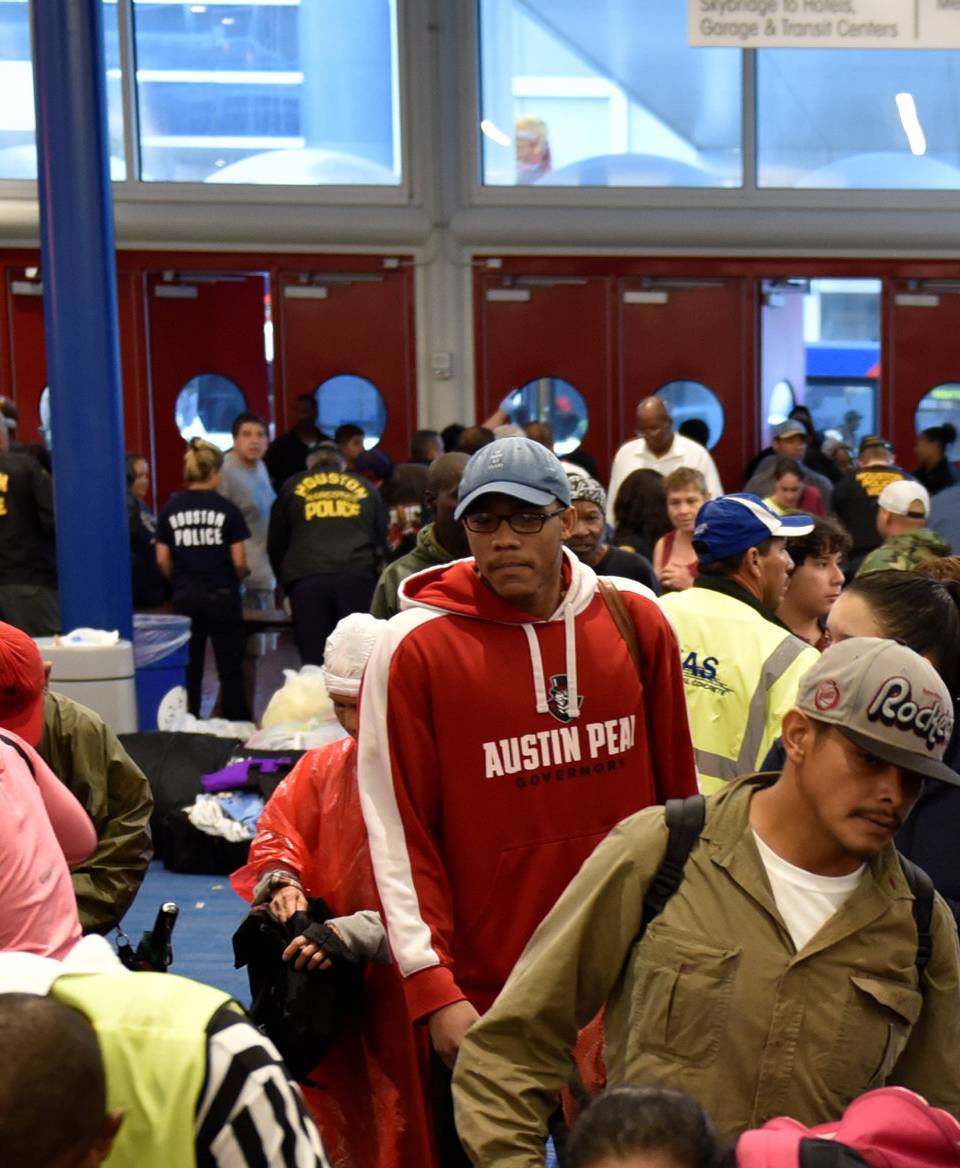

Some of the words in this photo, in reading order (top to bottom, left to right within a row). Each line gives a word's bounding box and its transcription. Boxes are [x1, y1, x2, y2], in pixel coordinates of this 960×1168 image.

[784, 0, 799, 12] to
[701, 18, 759, 39] Garage
[765, 18, 776, 36] &
[782, 18, 832, 37] Transit
[837, 18, 898, 37] Centers
[294, 472, 368, 499] HOUSTON
[169, 510, 226, 530] HOUSTON
[305, 499, 360, 521] POLICE
[174, 528, 223, 547] POLICE
[867, 677, 954, 748] Rocke
[482, 726, 582, 778] AUSTIN
